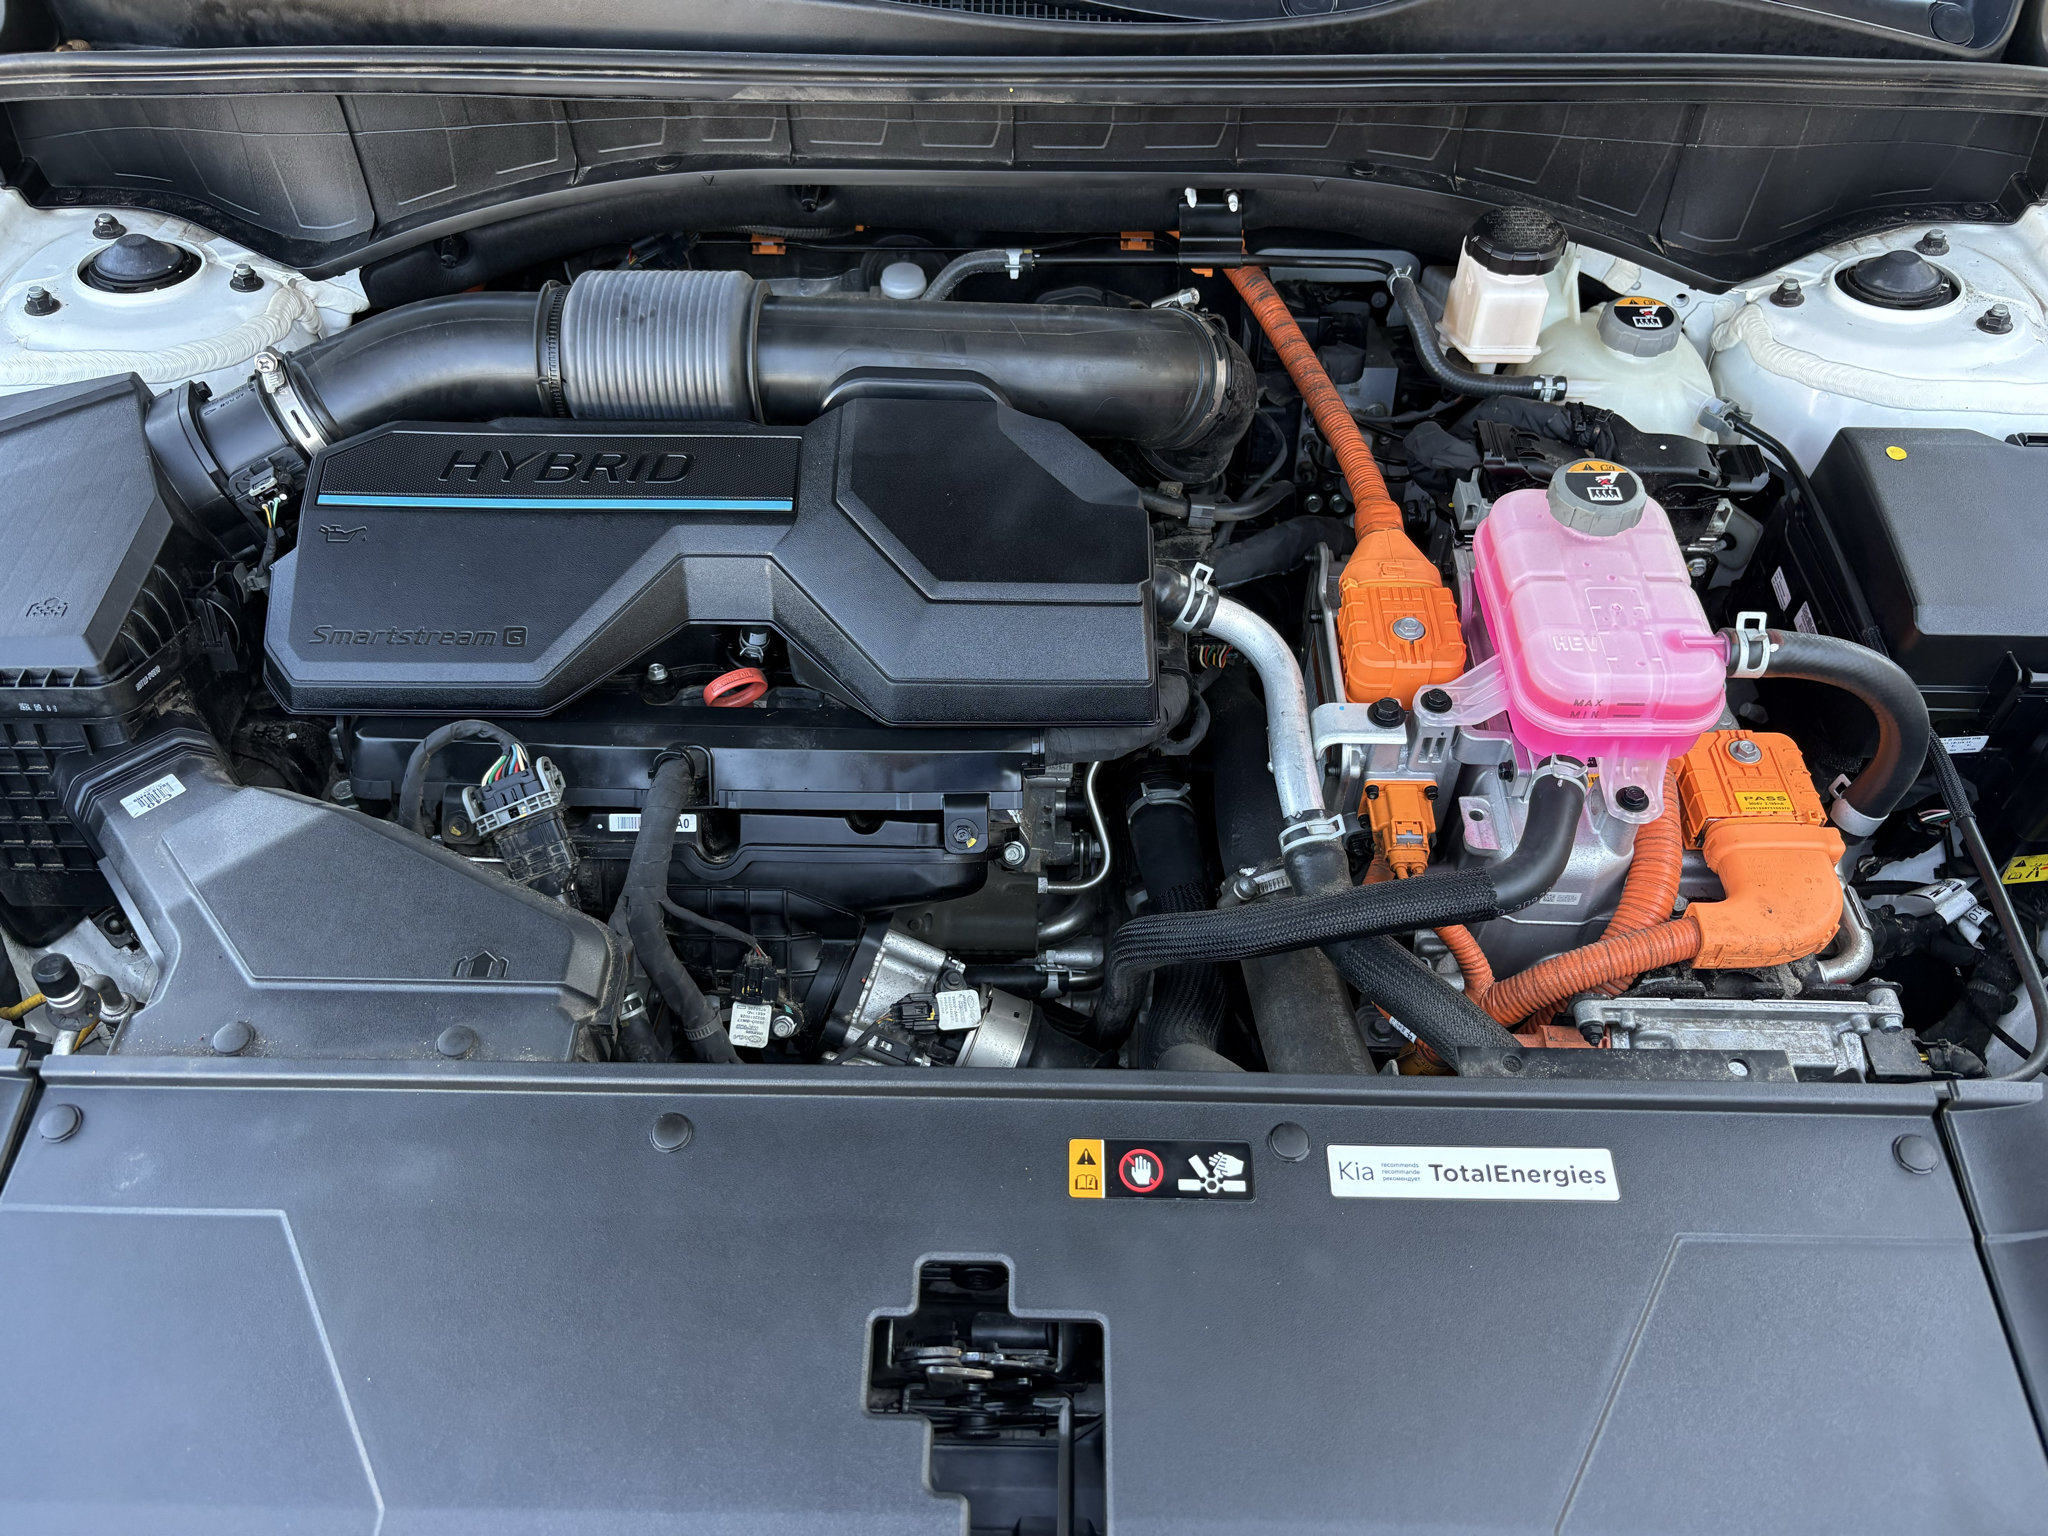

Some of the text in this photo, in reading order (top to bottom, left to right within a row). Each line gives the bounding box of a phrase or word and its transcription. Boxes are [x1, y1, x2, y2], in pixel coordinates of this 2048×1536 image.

[437, 449, 696, 484] HYBRID
[308, 624, 498, 647] Smartstream
[1552, 633, 1598, 652] HEV
[1572, 698, 1604, 708] MAX
[1569, 710, 1600, 720] MIN
[1338, 1161, 1375, 1181] Kia
[1428, 1163, 1607, 1188] TotalEnergies
